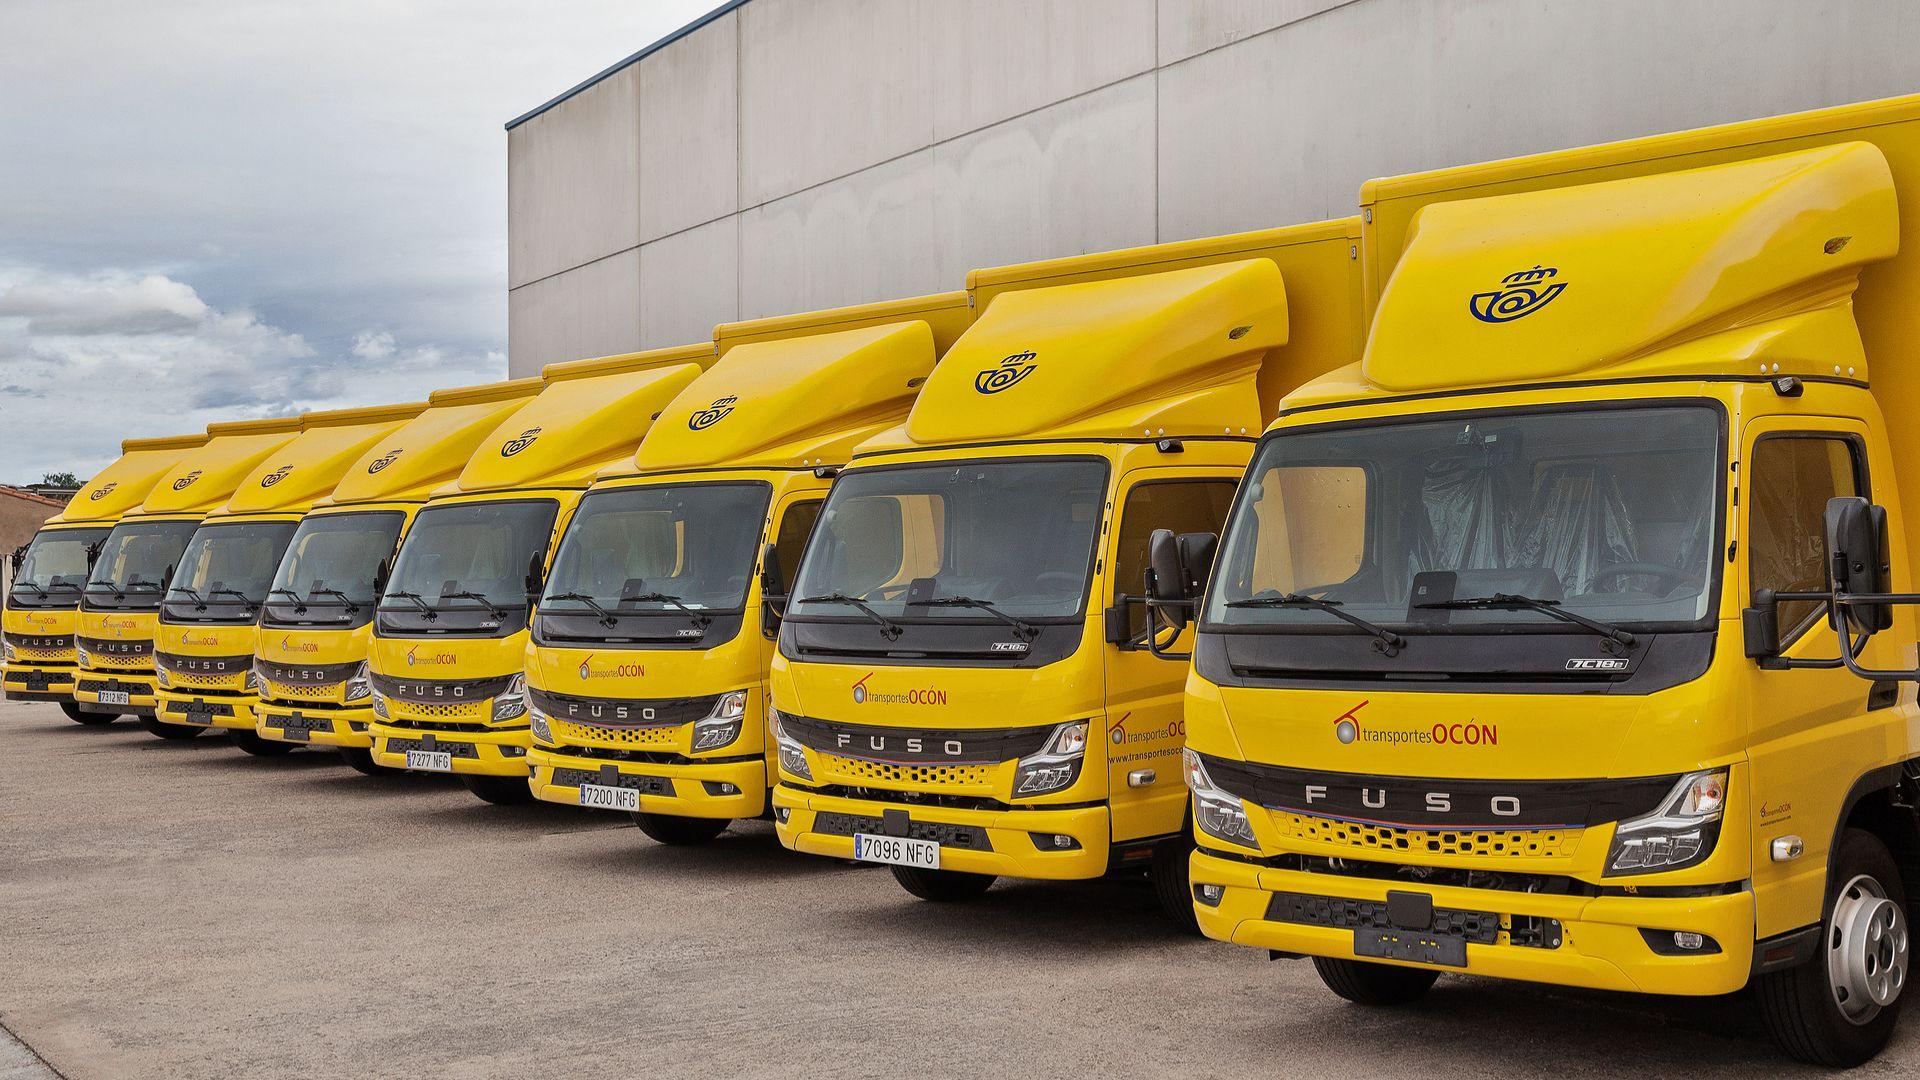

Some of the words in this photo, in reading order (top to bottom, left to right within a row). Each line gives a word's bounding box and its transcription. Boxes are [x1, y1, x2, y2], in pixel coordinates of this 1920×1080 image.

[22, 638, 64, 646] FUSO
[97, 644, 142, 652] FUSO
[176, 660, 225, 670] FUSO
[1571, 659, 1625, 669] 7C18e
[275, 669, 324, 680] FUSO
[101, 692, 116, 702] 7312
[399, 685, 464, 697] FUSO
[569, 704, 655, 720] FUSO
[836, 733, 962, 756] FUSO
[411, 752, 432, 767] 7277
[433, 754, 449, 769] NFG
[1107, 746, 1184, 764] www.transportesoco
[586, 787, 613, 805] 7200
[615, 790, 636, 808] NFG
[1305, 784, 1521, 817] FUSO
[864, 838, 901, 861] 7096
[906, 842, 934, 865] NFG
